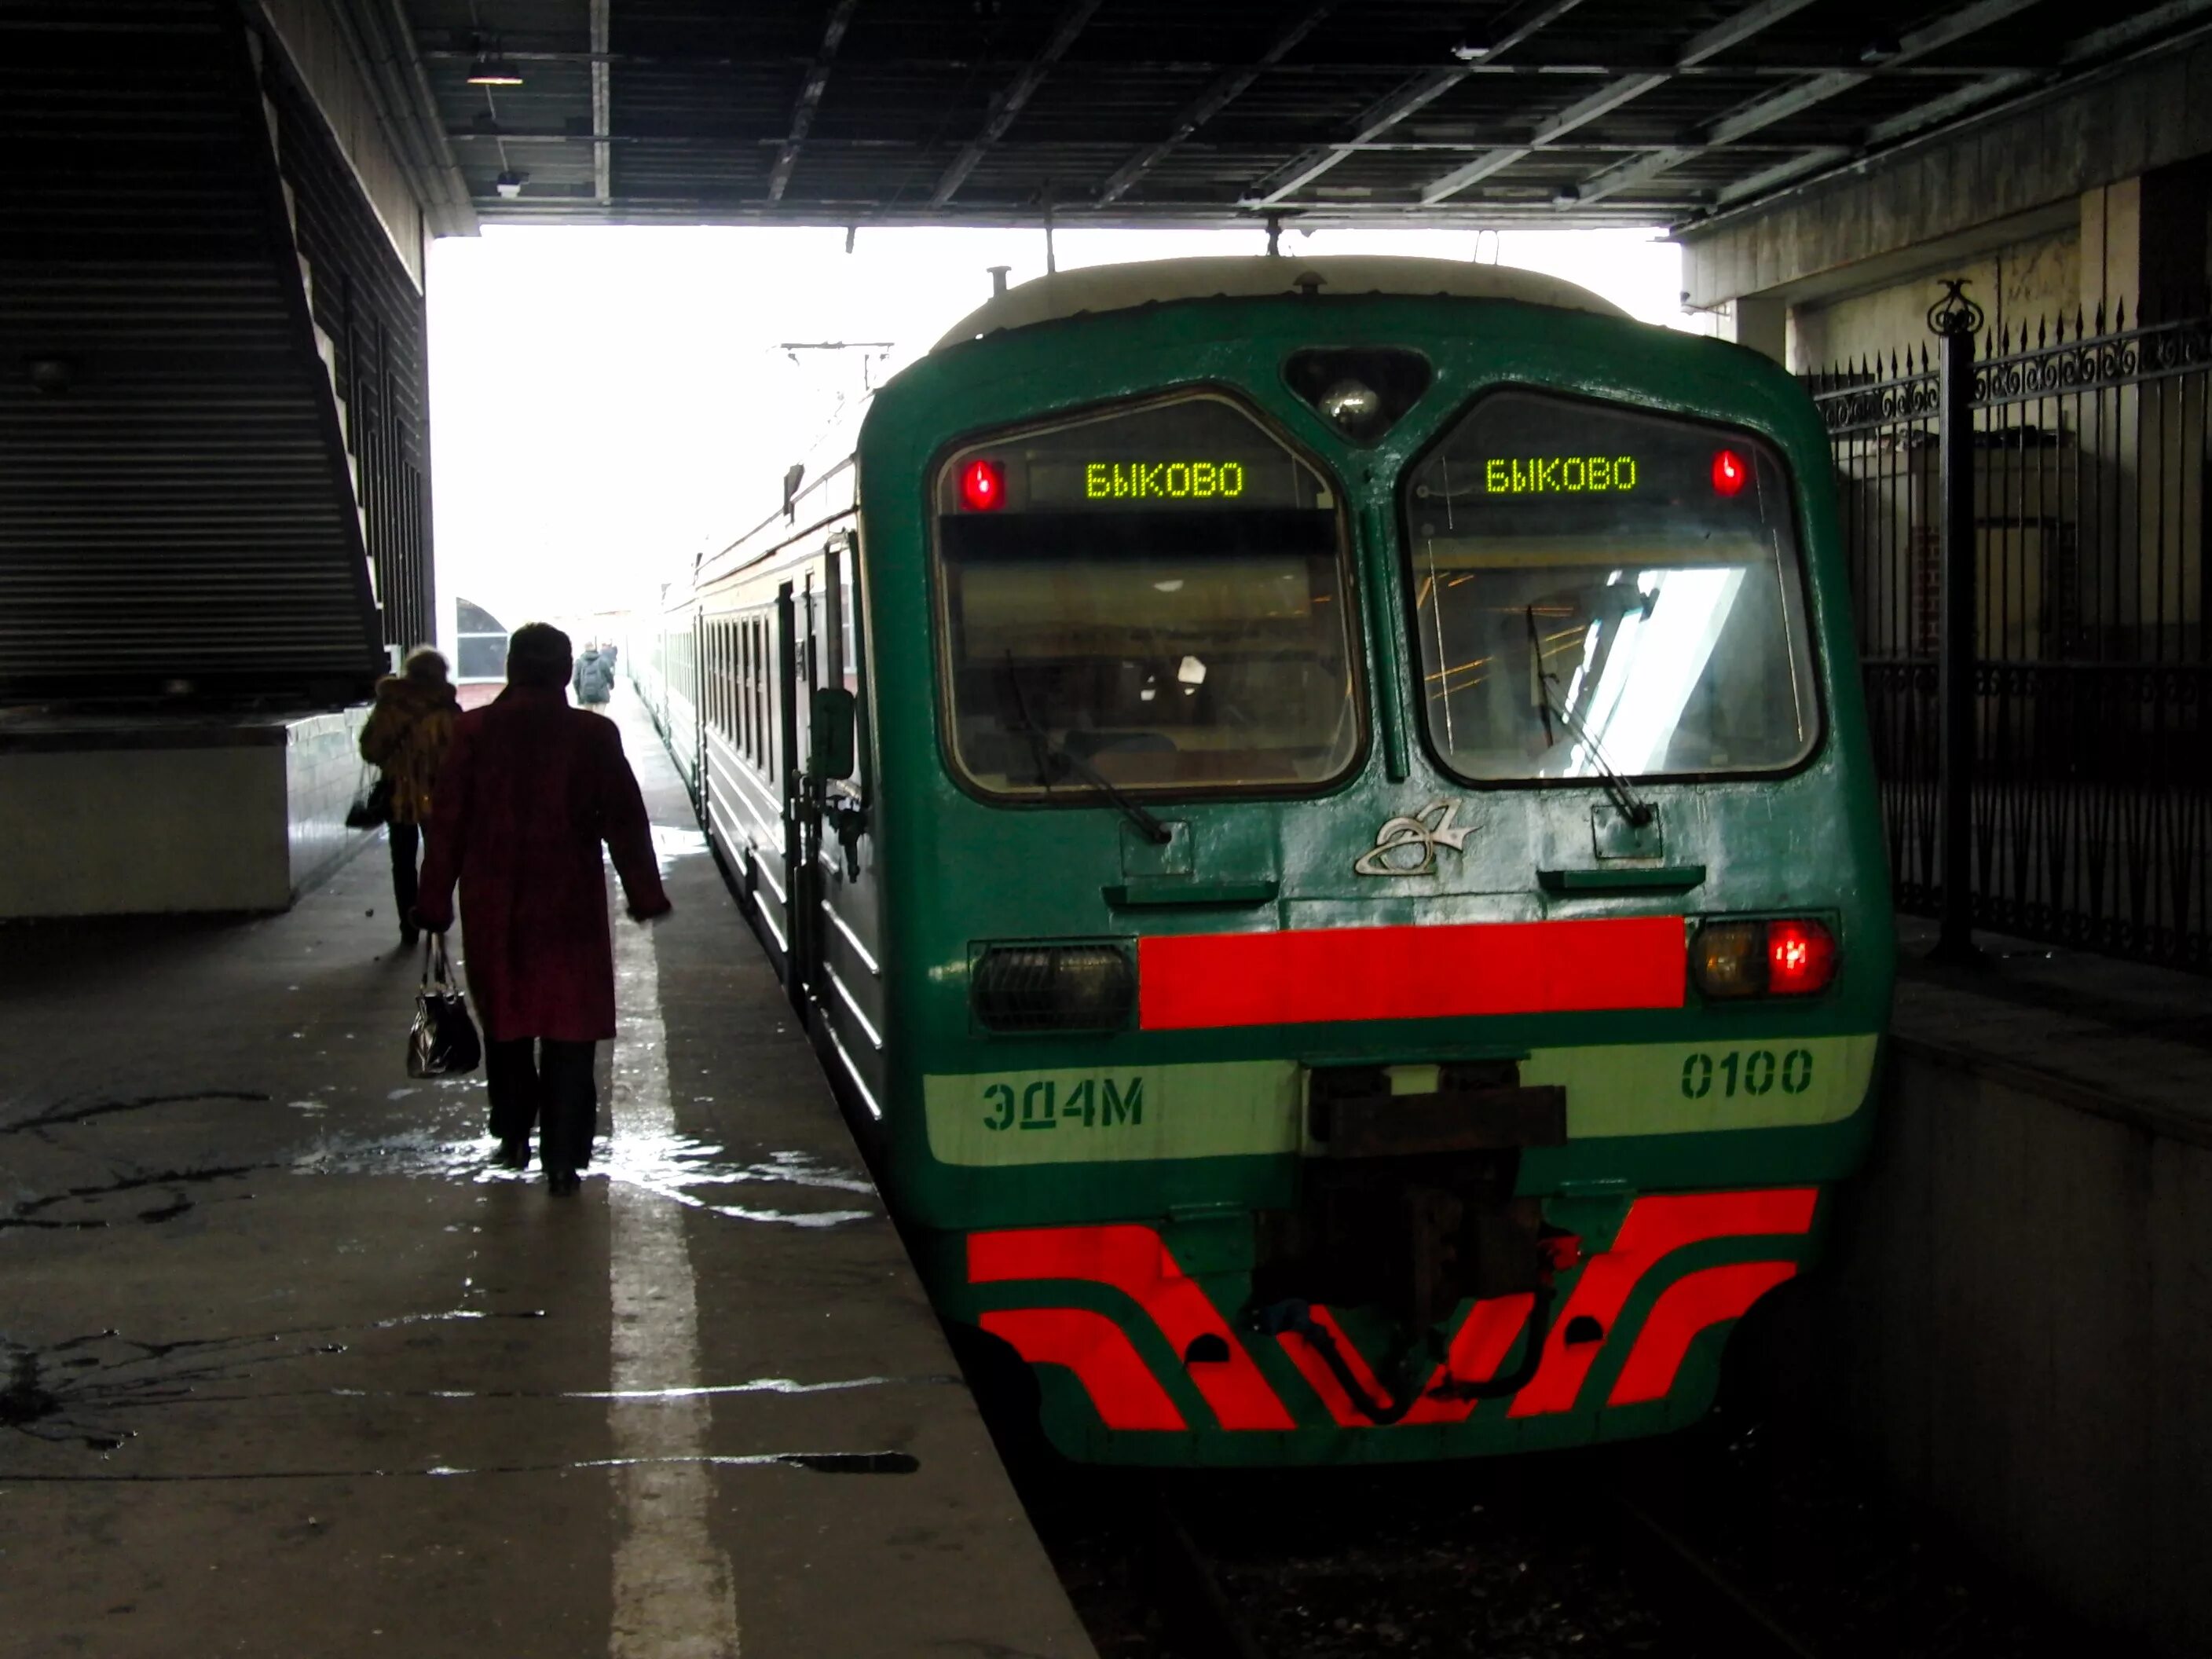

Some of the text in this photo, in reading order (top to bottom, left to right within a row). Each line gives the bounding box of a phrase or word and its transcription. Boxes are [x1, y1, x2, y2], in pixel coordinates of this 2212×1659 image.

[1086, 462, 1244, 499] БЫКОВО
[1485, 456, 1638, 493] БЫКОВО
[1682, 1049, 1813, 1099] 0100
[983, 1077, 1143, 1130] ЭД4М
